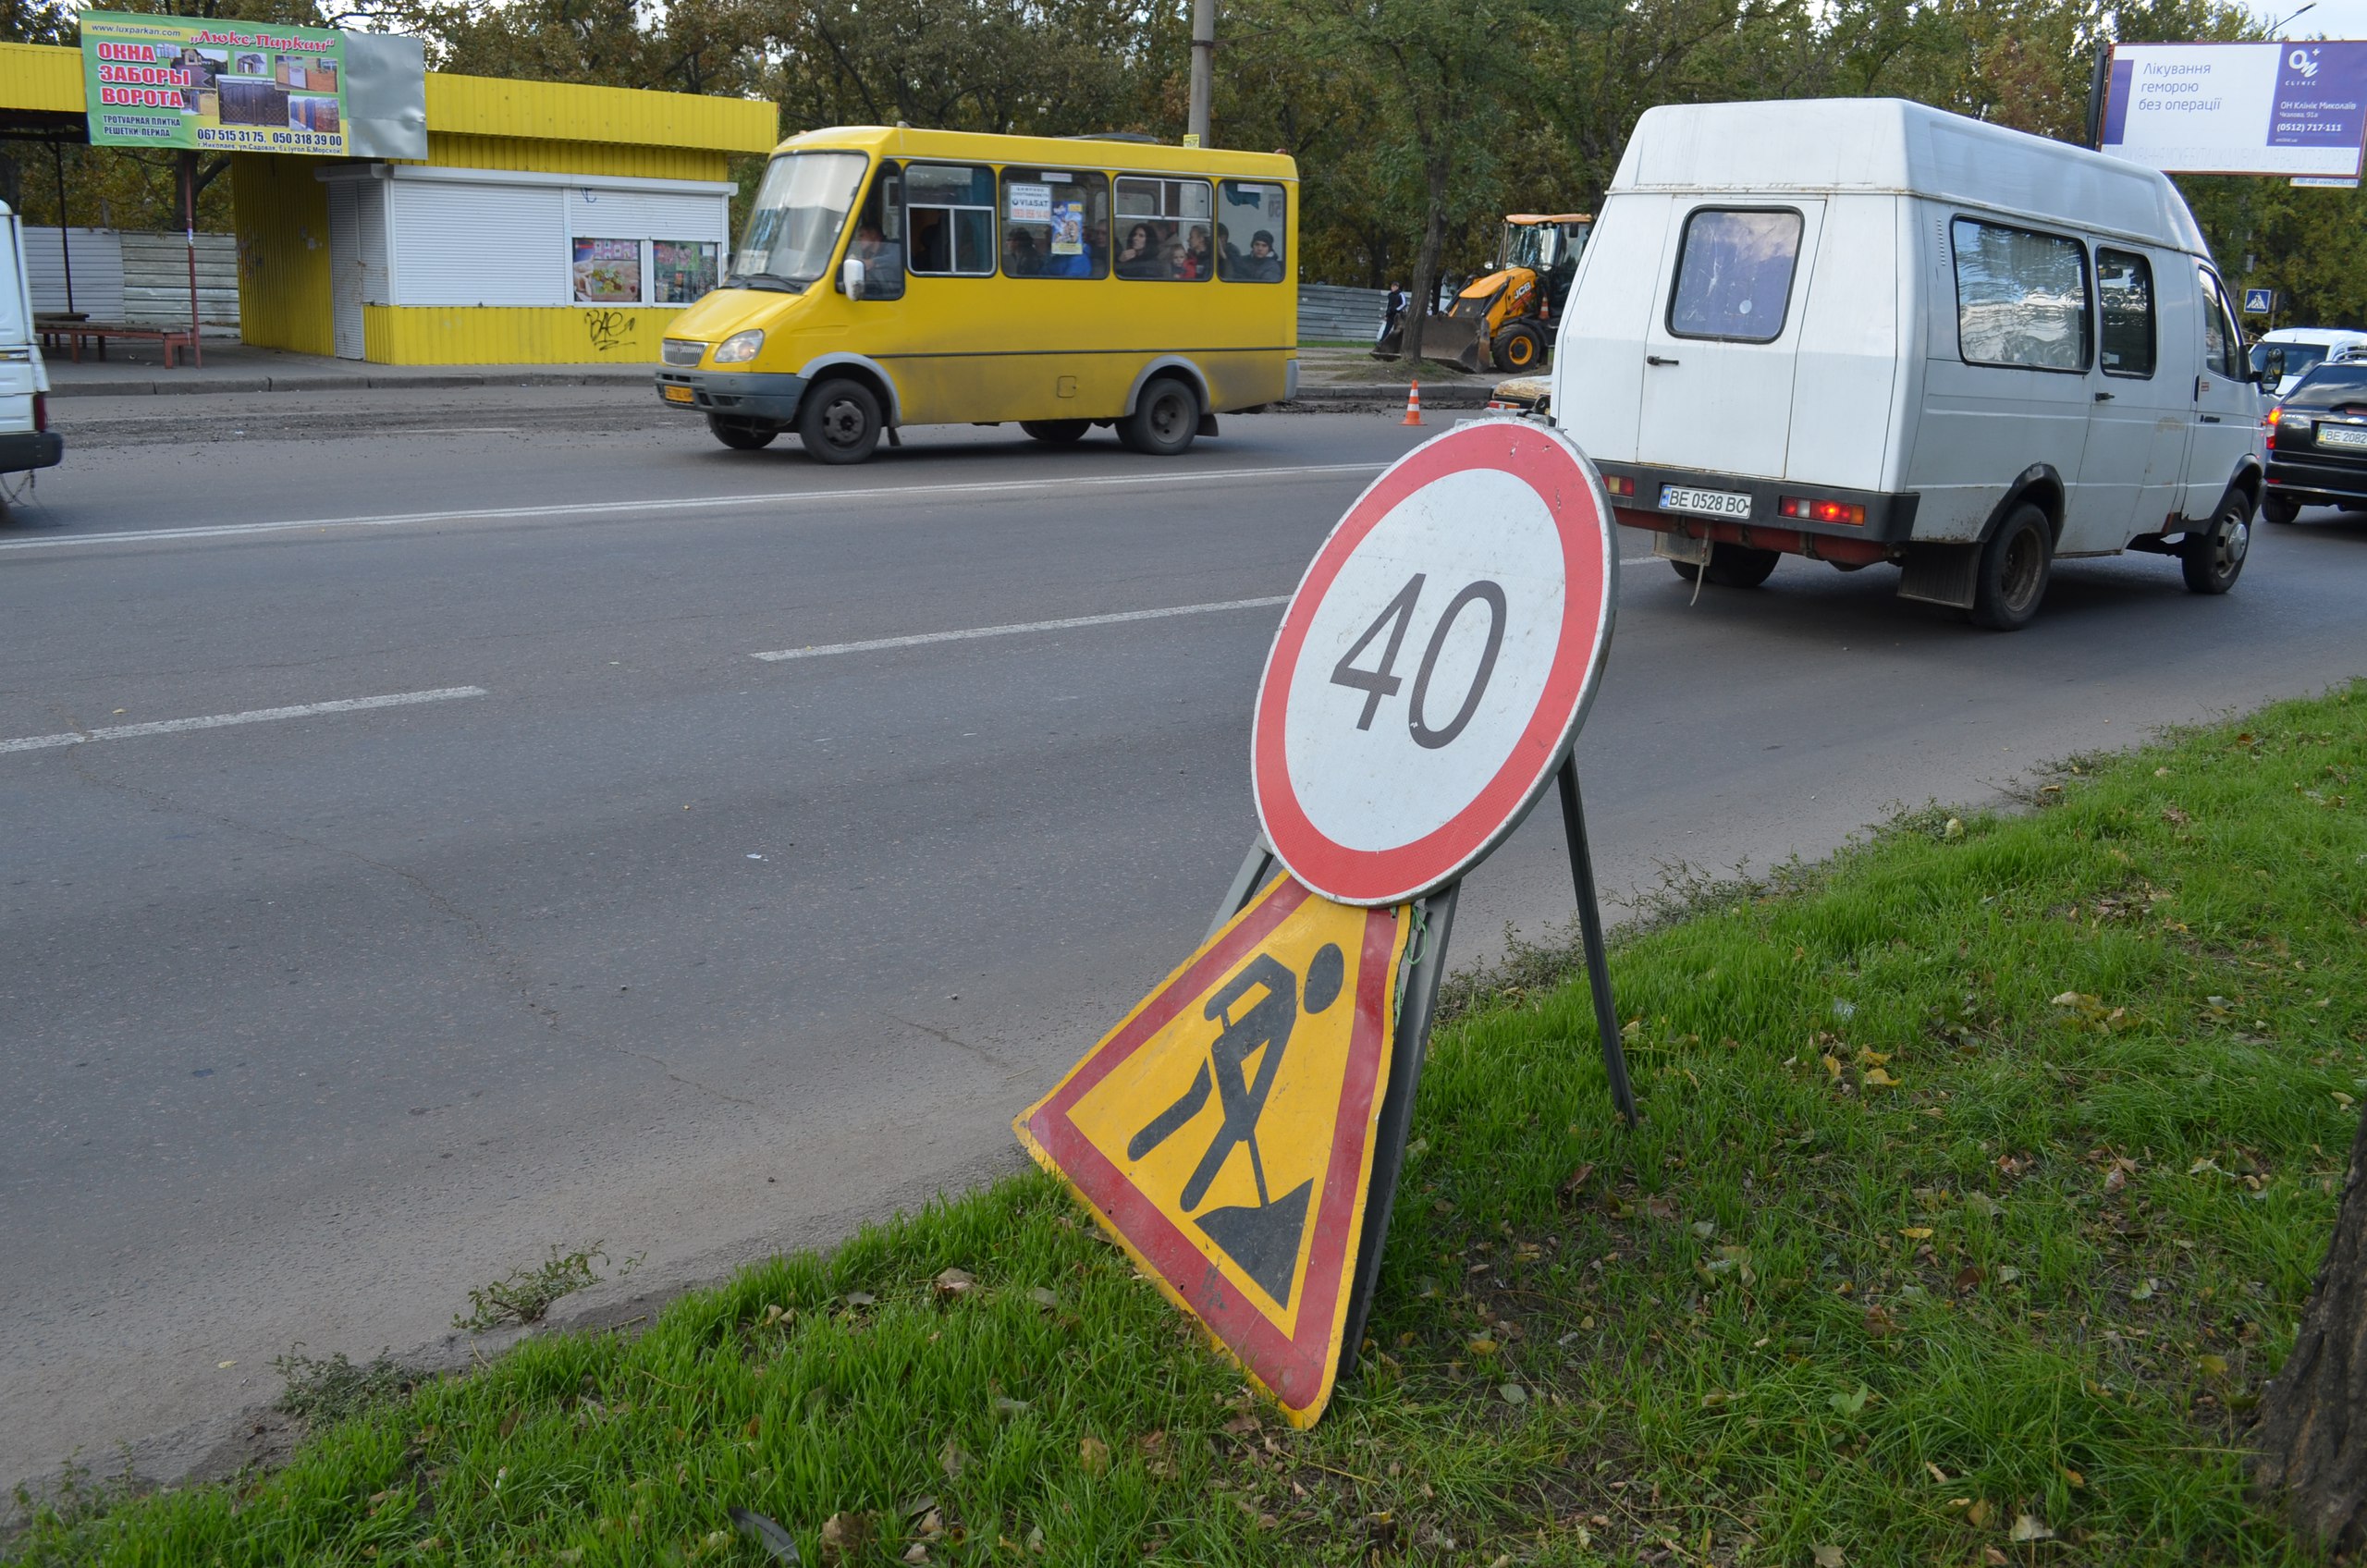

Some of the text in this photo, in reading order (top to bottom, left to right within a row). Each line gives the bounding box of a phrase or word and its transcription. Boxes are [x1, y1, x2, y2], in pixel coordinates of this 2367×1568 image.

[92, 24, 181, 37] www.luxparkan.com
[98, 43, 156, 62] ОКНА
[99, 65, 190, 86] ЗАБОРЫ
[2143, 62, 2212, 78] Лікування
[2140, 81, 2200, 96] геморою
[102, 87, 184, 108] ВОРОТА
[2139, 97, 2223, 114] без операції
[2280, 101, 2357, 111] ОН Клінік Миколаїв
[103, 115, 181, 127] ТРОТУАРНАЯ ПЛИТКА
[2276, 123, 2342, 133] (0512) 717-111
[141, 128, 171, 138] ПЕРИЛА
[197, 128, 216, 141] 067
[217, 129, 237, 142] 515
[238, 131, 252, 143] 31
[272, 132, 293, 145] 050
[294, 133, 313, 146] 318
[314, 135, 327, 146] 39
[329, 135, 343, 147] 00
[1514, 281, 1531, 300] JCB
[2325, 430, 2367, 444] BE 2082
[1670, 491, 1747, 513] BE 0528 BO
[1330, 573, 1507, 750] 40
